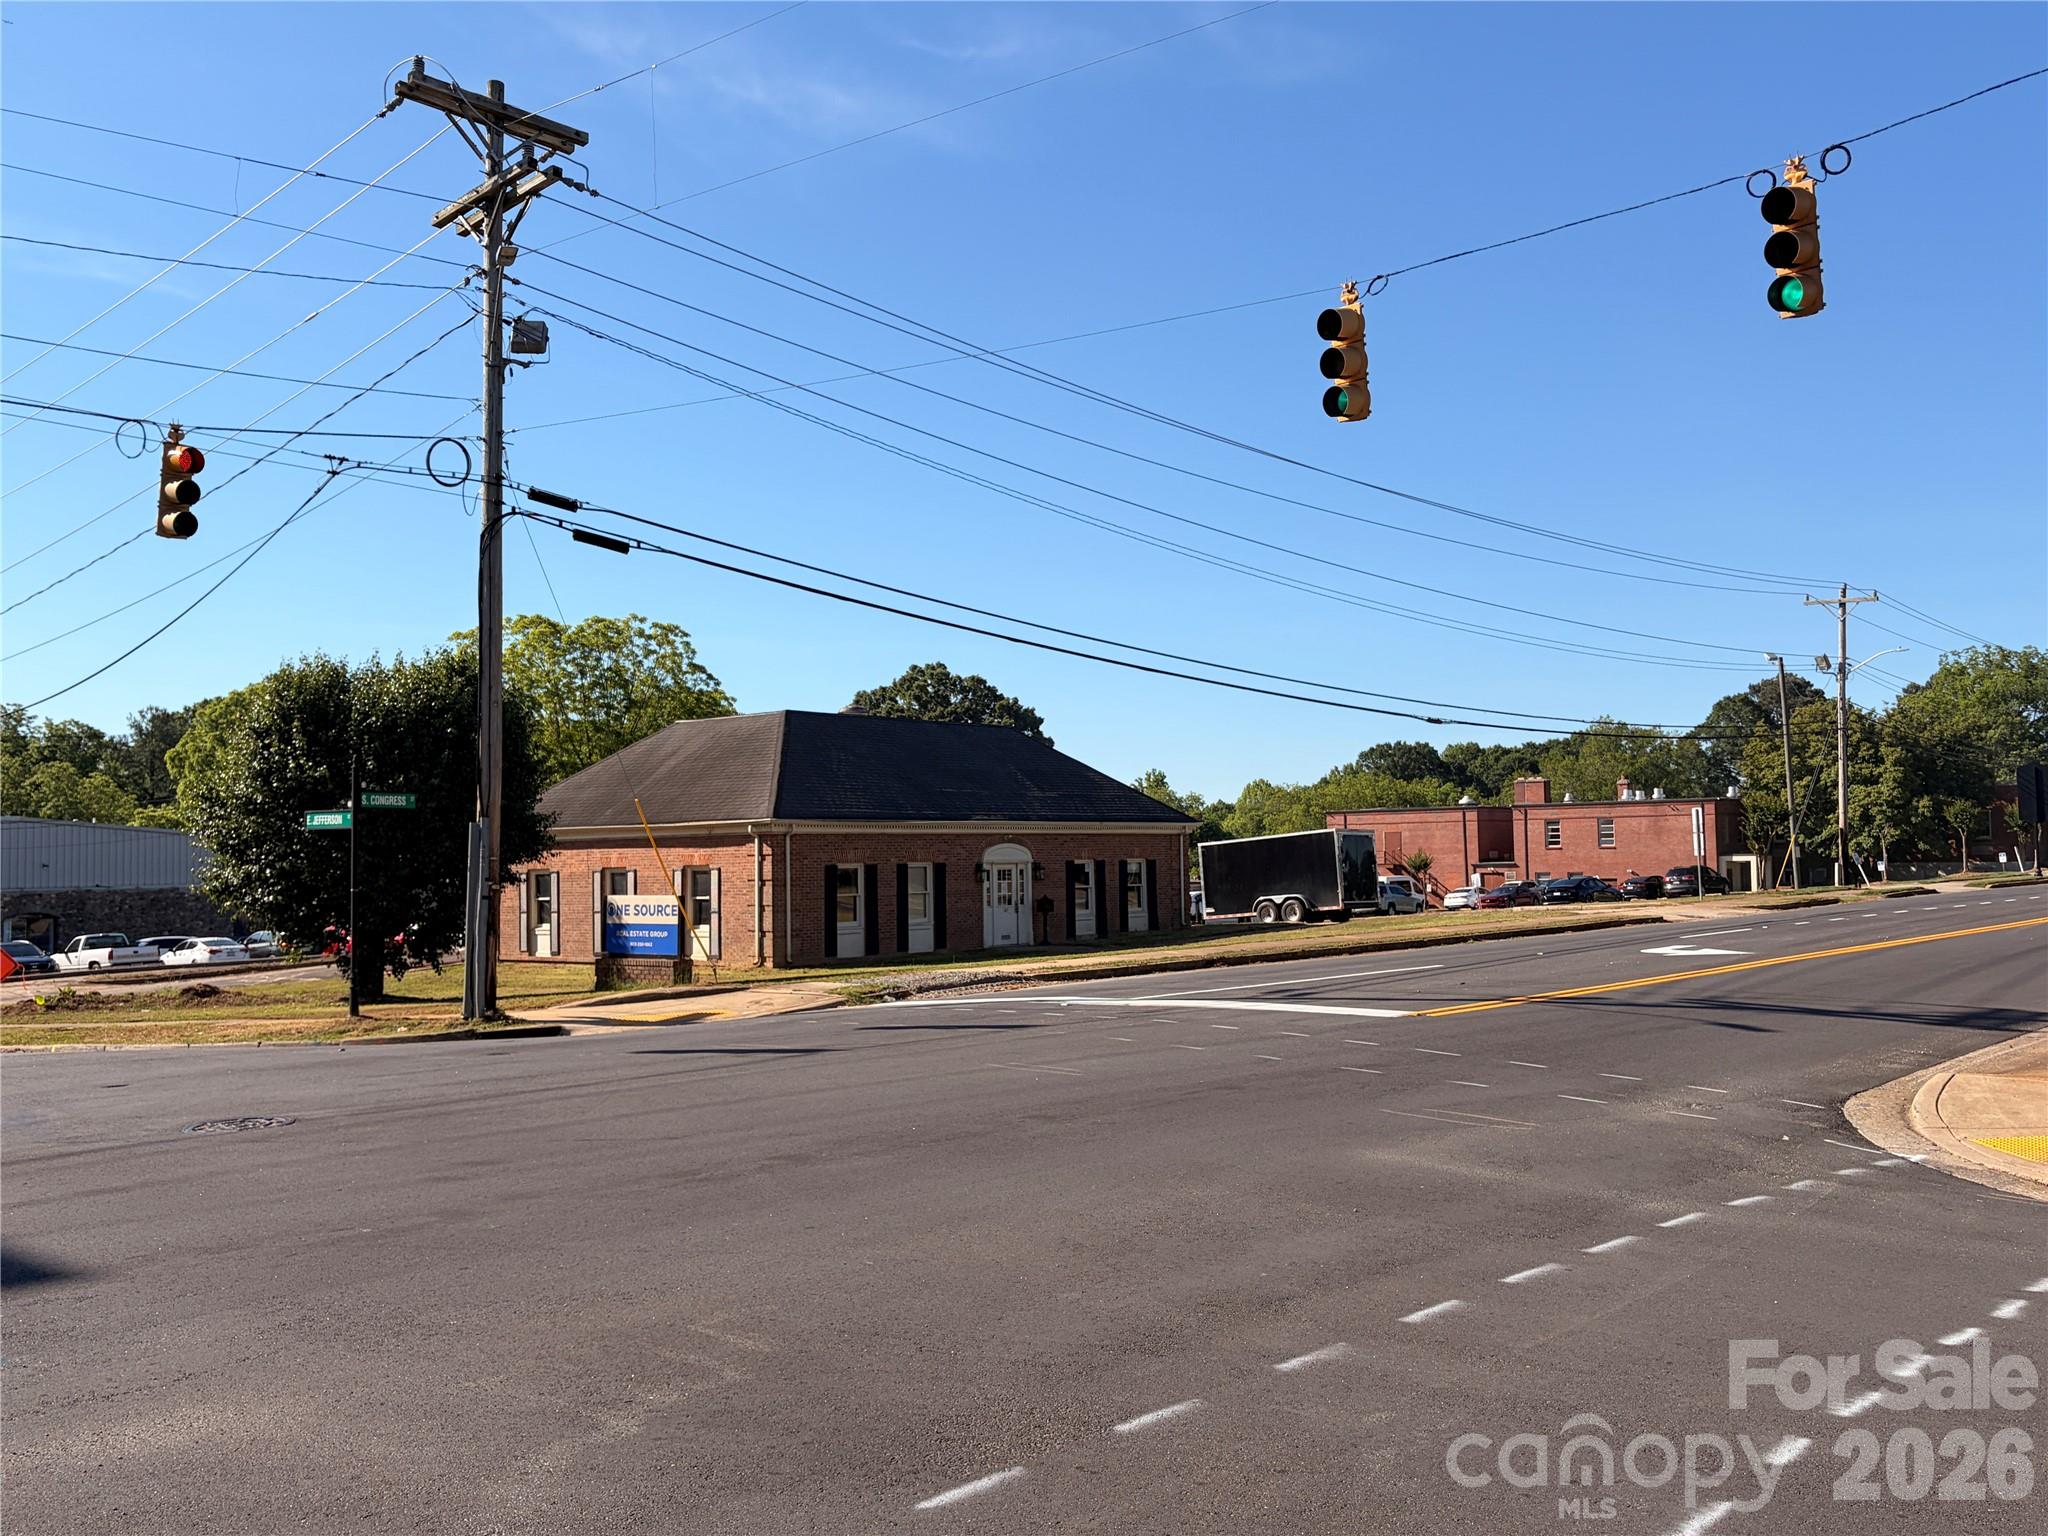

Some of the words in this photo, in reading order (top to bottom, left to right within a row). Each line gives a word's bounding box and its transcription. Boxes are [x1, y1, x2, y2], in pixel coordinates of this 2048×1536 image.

[361, 795, 369, 805] S.
[370, 795, 407, 806] CONGRESS
[313, 815, 342, 825] JEFFERSON
[607, 902, 631, 917] ONE
[633, 904, 678, 917] SOURCE
